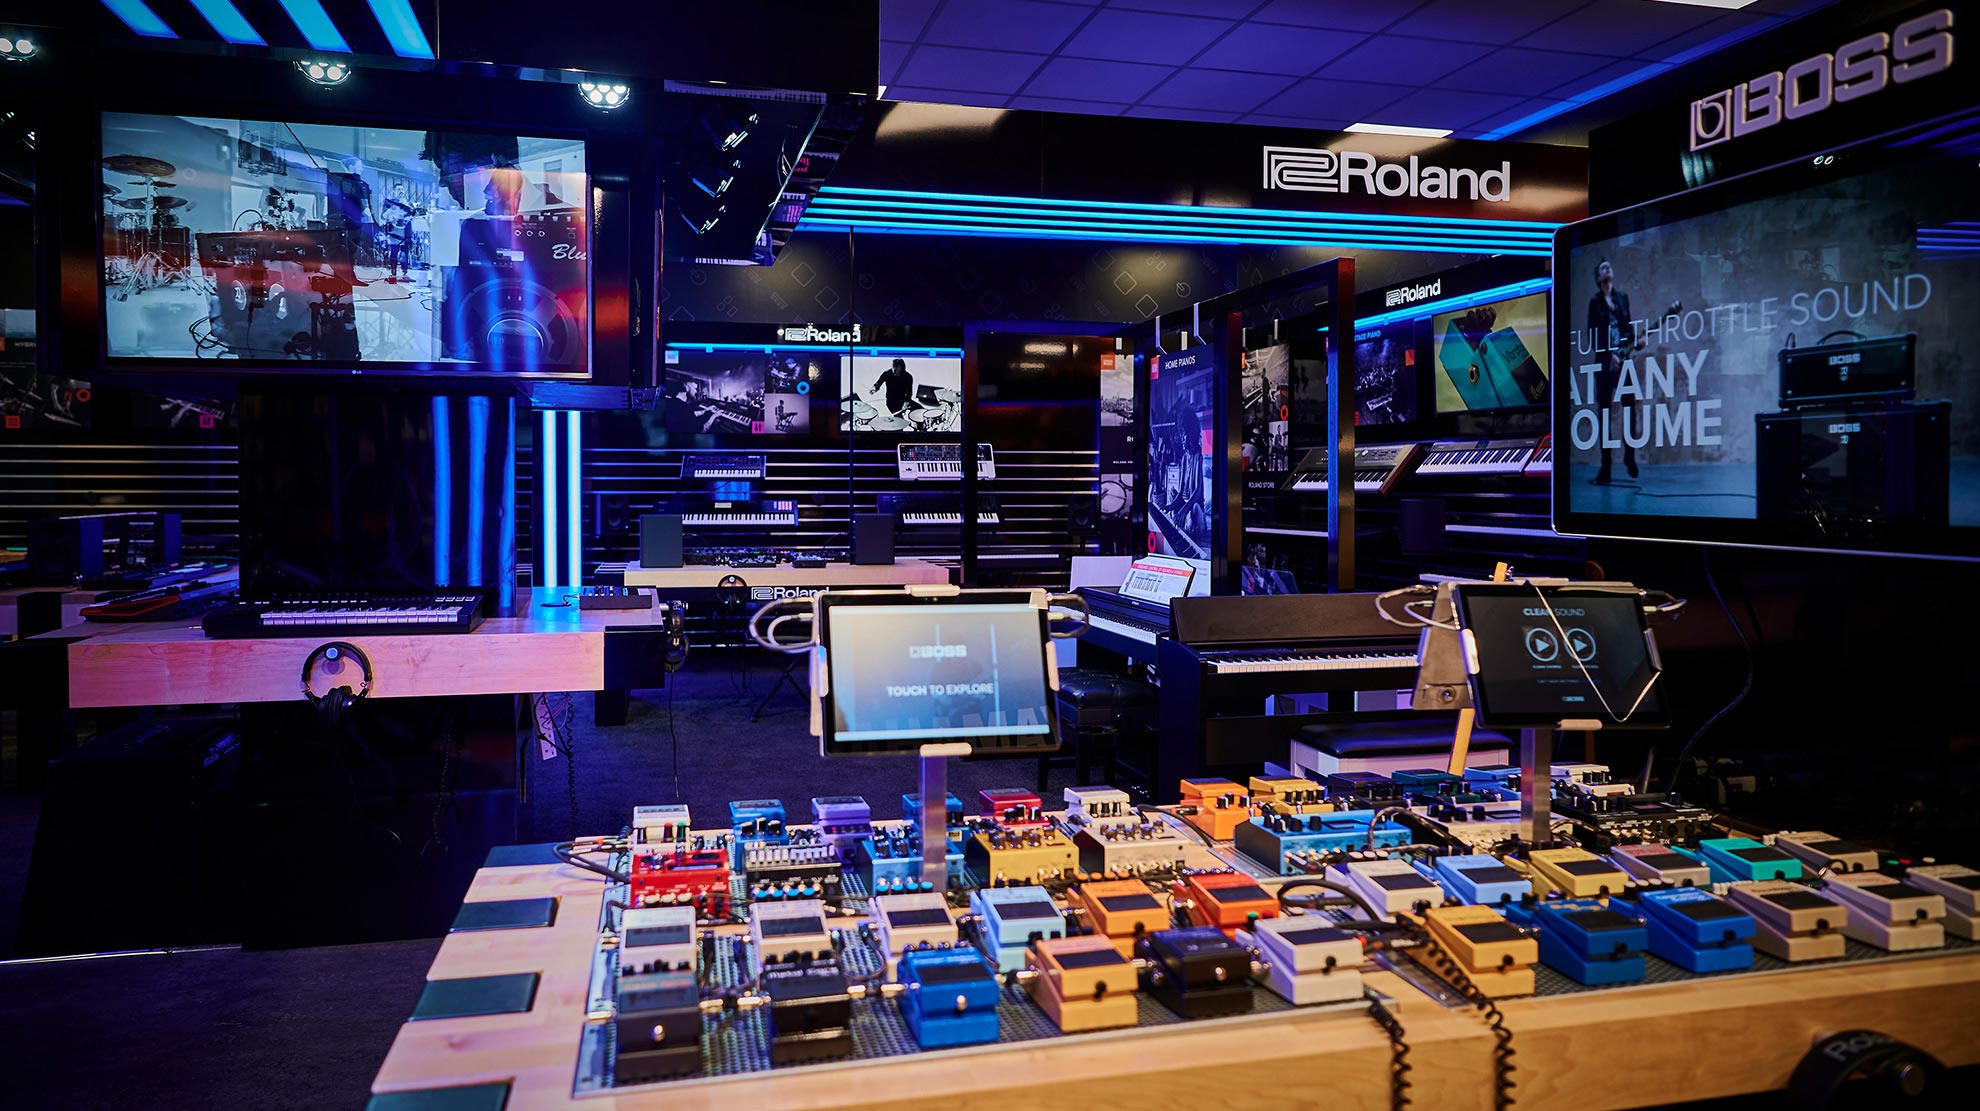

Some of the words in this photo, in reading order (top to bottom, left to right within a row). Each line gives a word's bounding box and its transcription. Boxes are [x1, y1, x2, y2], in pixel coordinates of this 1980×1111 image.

[1733, 8, 1954, 138] BOSS
[1340, 150, 1511, 203] Roland
[1401, 278, 1441, 304] Roland
[1790, 273, 1932, 326] SOUND
[807, 327, 861, 343] Roland
[1165, 359, 1178, 370] HOME
[1178, 355, 1196, 367] PIANOS
[1829, 353, 1861, 366] BOSS
[1613, 349, 1710, 403] ANY
[1570, 399, 1722, 451] OLUME
[1829, 422, 1861, 433] BOSS
[1523, 607, 1553, 616] CLEA
[1554, 608, 1585, 616] SOUND
[921, 645, 967, 658] BOSS
[886, 685, 928, 697] TOUCH
[930, 684, 945, 696] TO
[946, 682, 994, 696] EXPLORE
